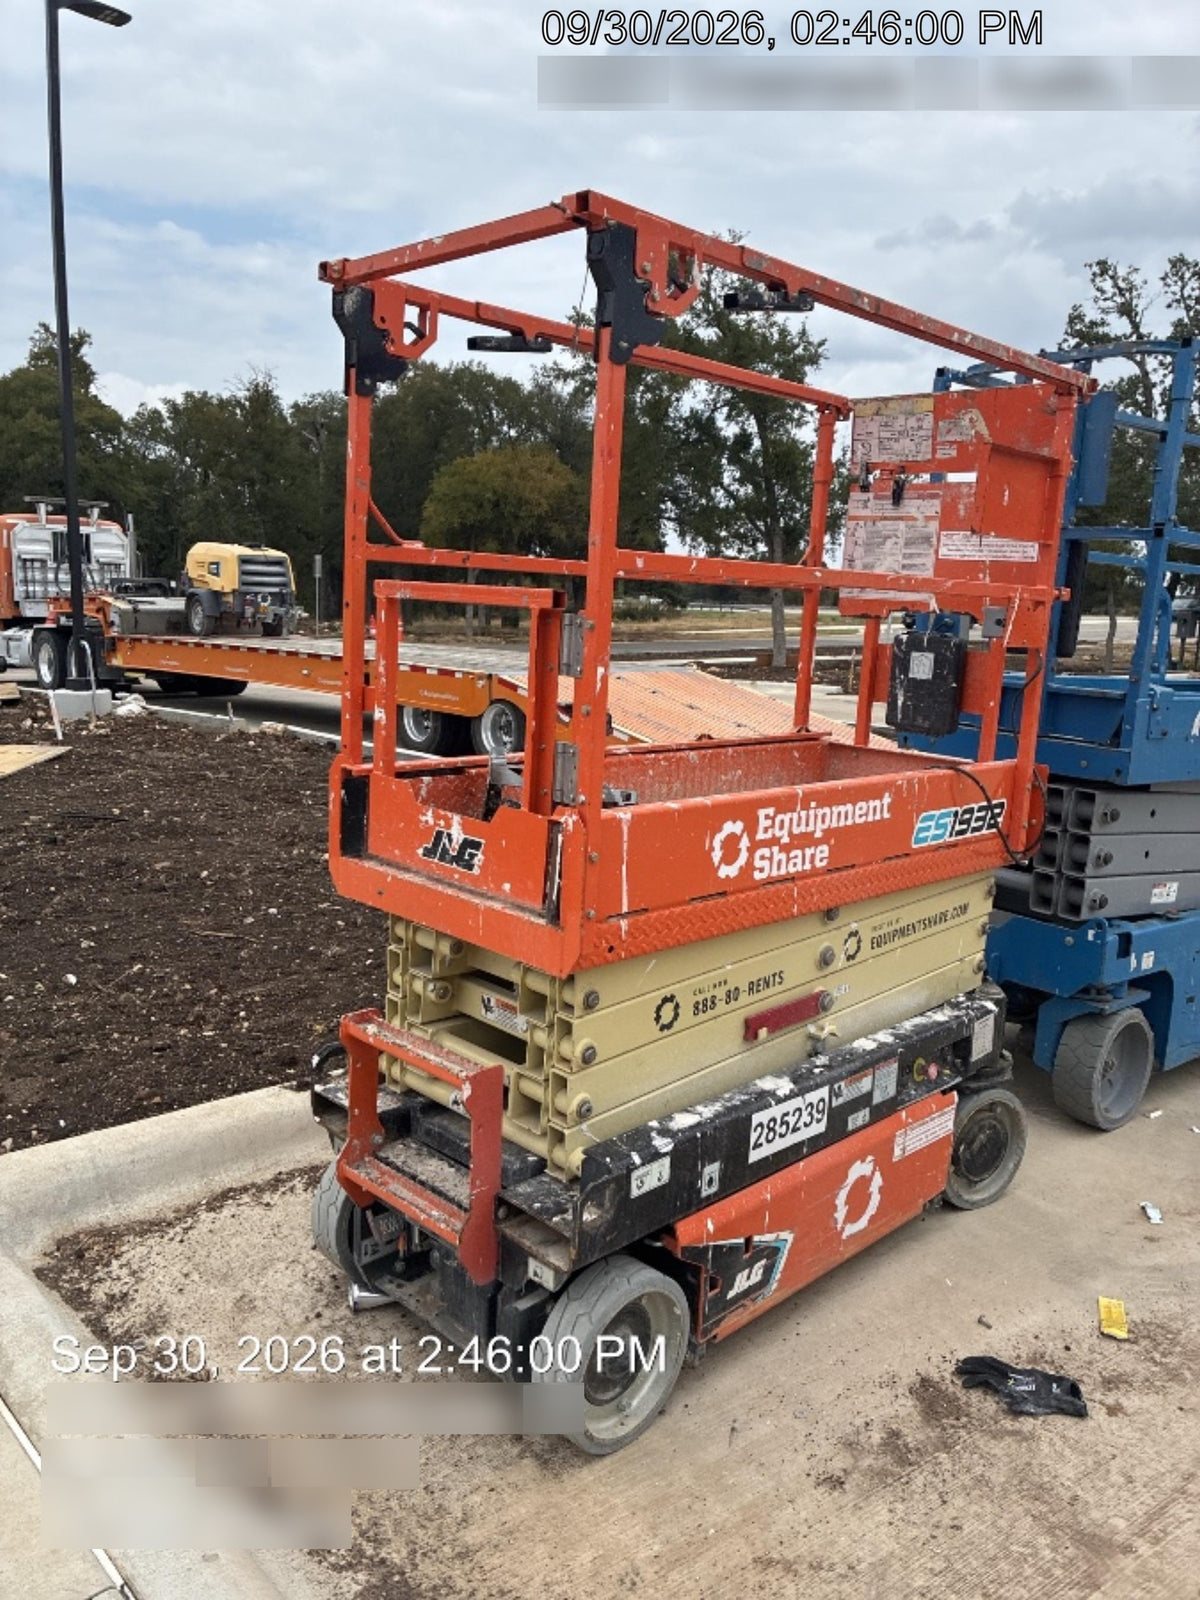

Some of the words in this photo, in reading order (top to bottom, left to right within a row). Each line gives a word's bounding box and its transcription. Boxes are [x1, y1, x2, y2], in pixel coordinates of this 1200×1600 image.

[755, 792, 892, 844] Equipment
[753, 844, 829, 880] Share
[692, 970, 785, 1016] 888-80-RENTS
[751, 1097, 826, 1151] 285239
